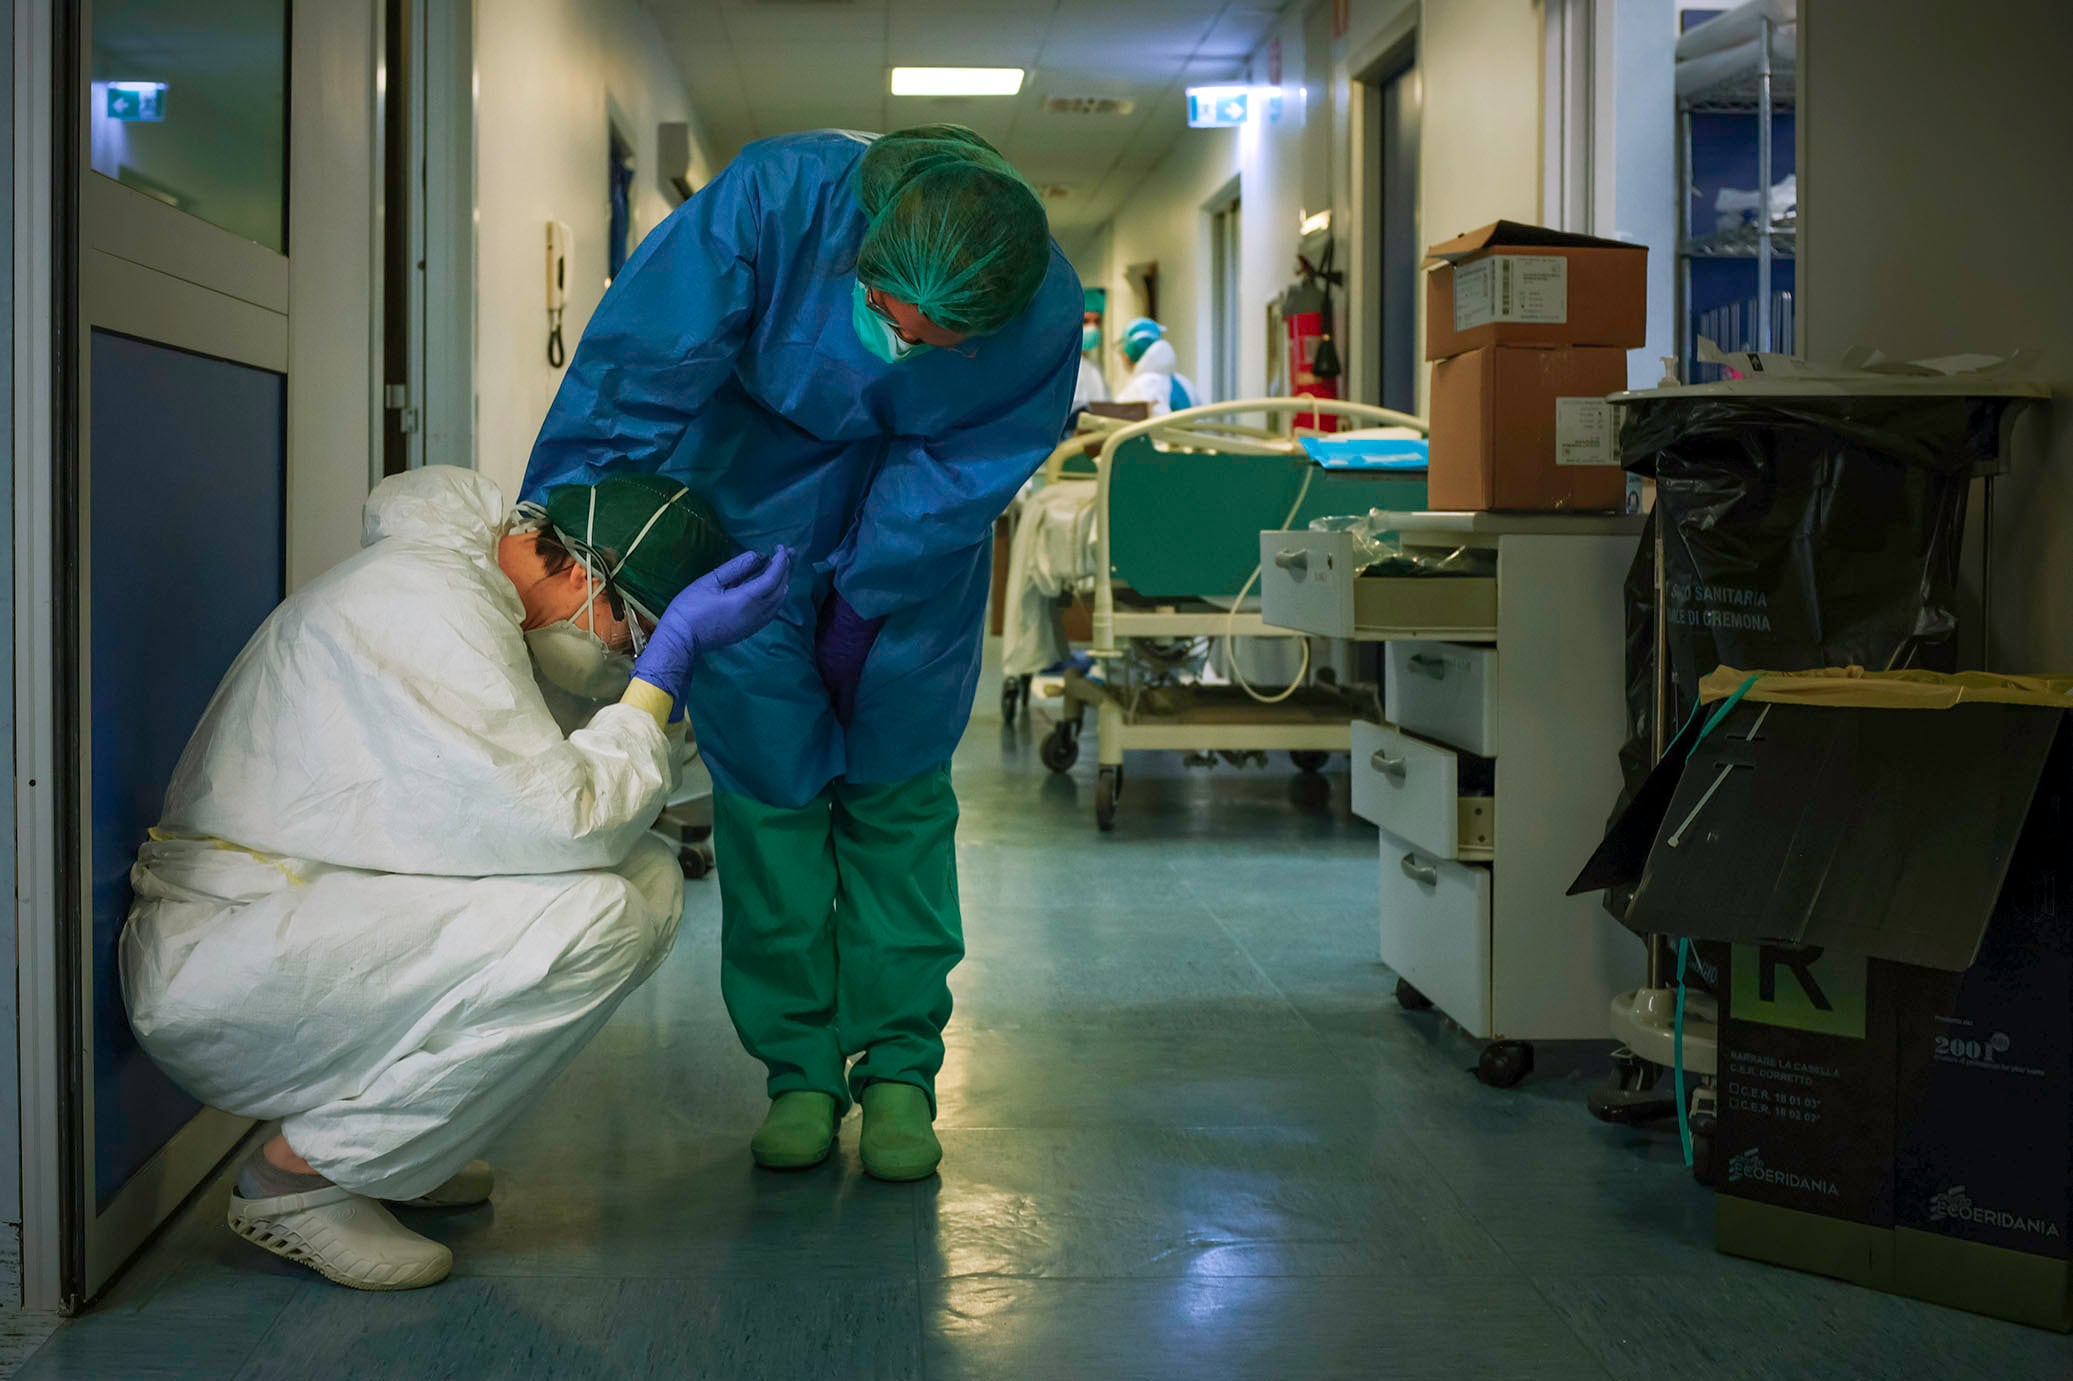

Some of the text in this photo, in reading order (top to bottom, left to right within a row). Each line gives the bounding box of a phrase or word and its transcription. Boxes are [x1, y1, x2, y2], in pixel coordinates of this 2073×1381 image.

[1695, 586, 1768, 608] SANITARIA
[1688, 610, 1699, 626] DI
[1703, 609, 1772, 632] CREMONA
[1759, 945, 1833, 1011] R
[1778, 1059, 1791, 1069] LA
[1789, 1095, 1800, 1106] 01
[1734, 1162, 1840, 1197] ECOERIDANIA
[1936, 1200, 2060, 1237] ECOERIDANIA
